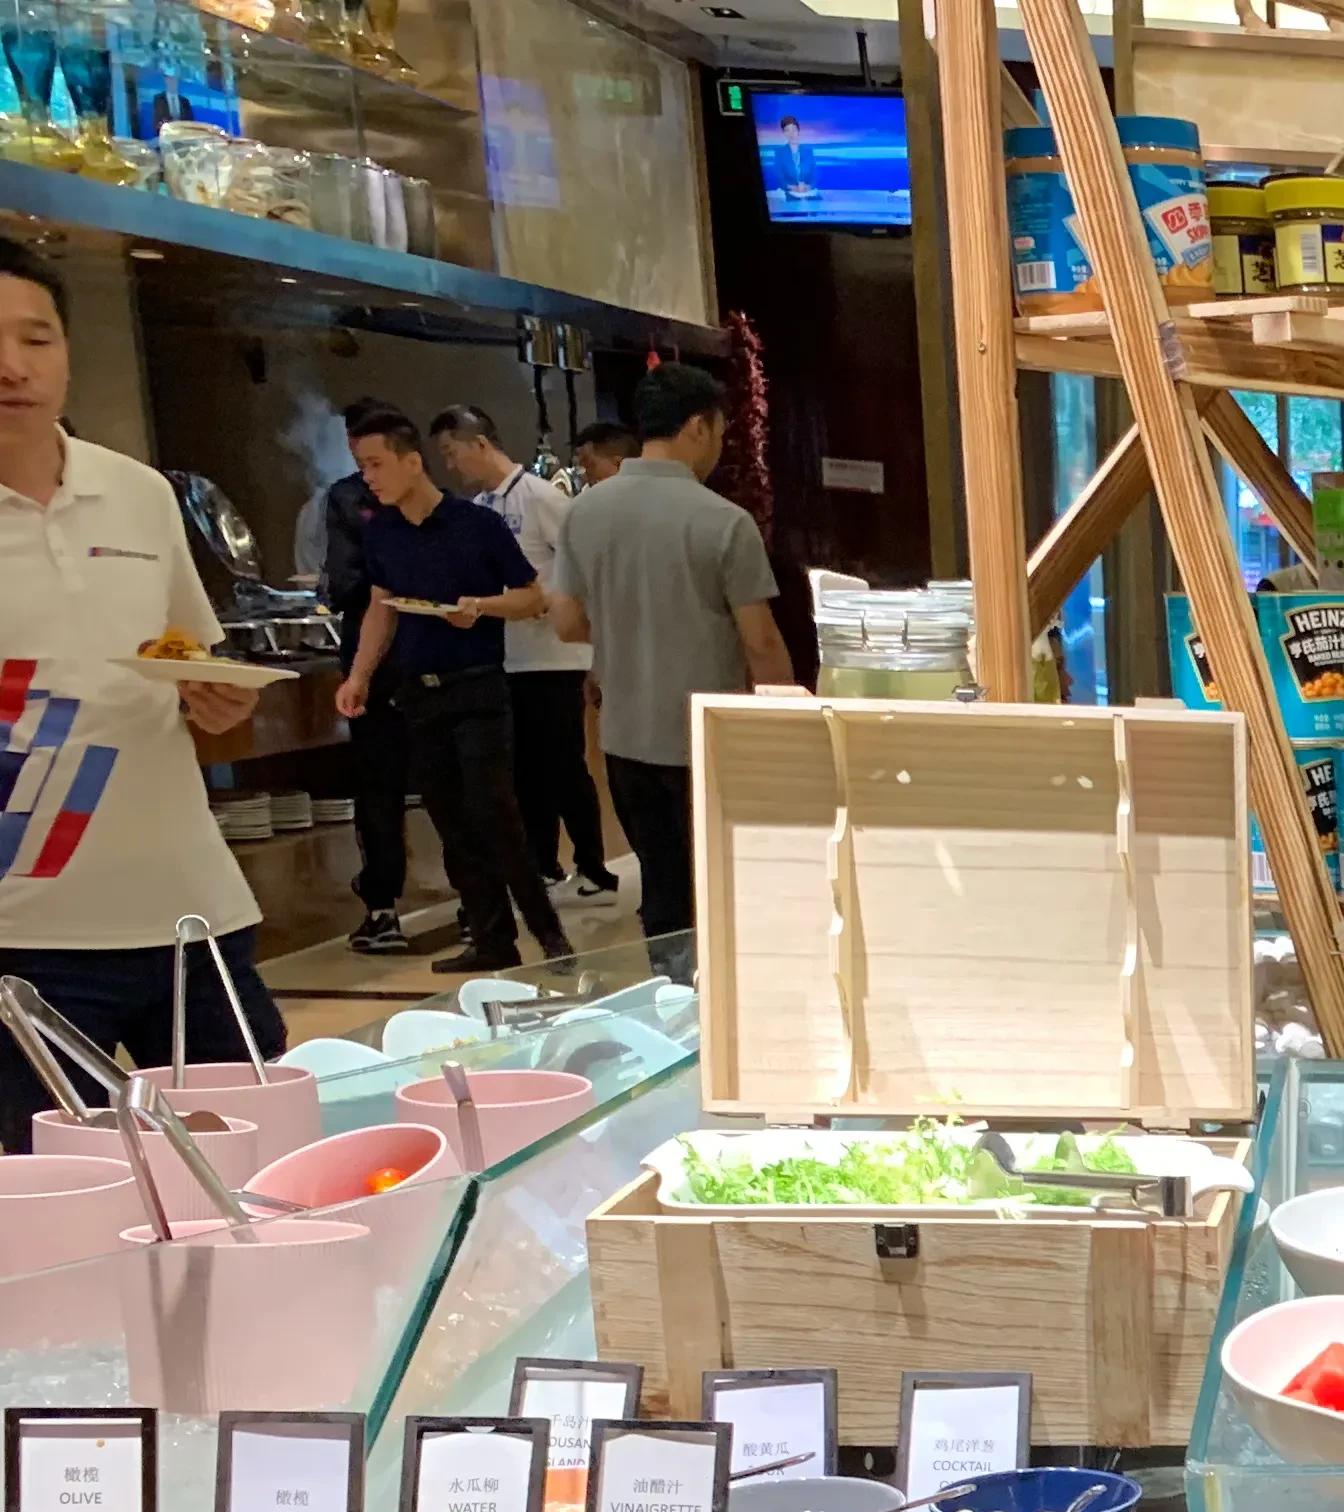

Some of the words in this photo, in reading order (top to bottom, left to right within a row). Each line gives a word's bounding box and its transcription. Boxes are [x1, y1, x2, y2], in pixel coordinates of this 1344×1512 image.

[933, 1460, 992, 1472] COCKTAIL
[64, 1467, 99, 1483] 橄榄
[448, 1478, 500, 1493] 水瓜柳
[633, 1479, 684, 1494] 油醋汁
[59, 1491, 103, 1505] OLIVE
[276, 1489, 309, 1506] 橄榄
